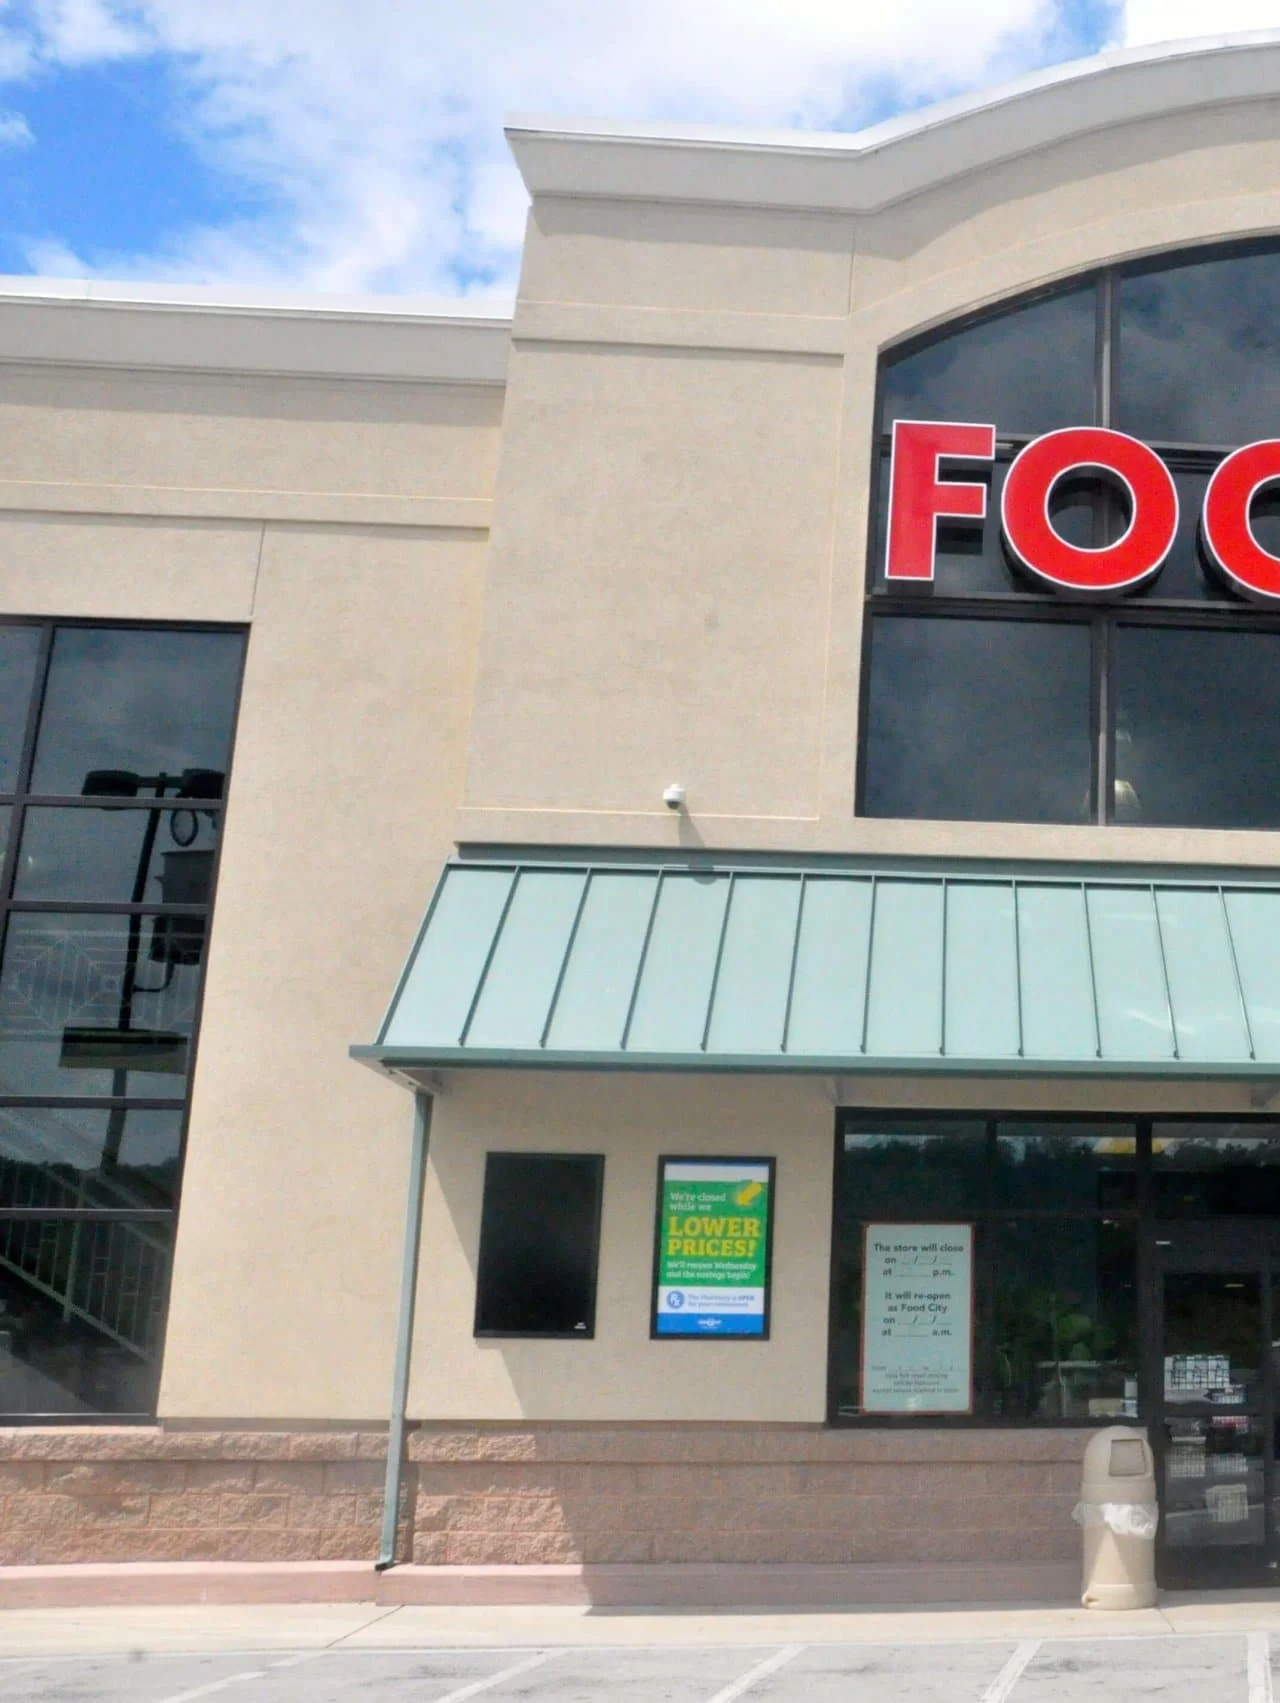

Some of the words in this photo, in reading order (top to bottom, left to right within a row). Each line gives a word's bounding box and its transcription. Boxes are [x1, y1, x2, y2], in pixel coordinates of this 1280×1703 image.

[668, 1215, 761, 1237] LOWER
[667, 1238, 758, 1257] PRICES!
[873, 1243, 891, 1252] The
[893, 1243, 918, 1252] store
[920, 1243, 938, 1252] will
[939, 1243, 964, 1252] close
[882, 1268, 892, 1276] at
[932, 1269, 955, 1278] p.m.
[884, 1291, 892, 1300] It
[894, 1291, 912, 1300] will
[913, 1292, 951, 1302] re-open
[901, 1303, 926, 1312] Food
[927, 1303, 948, 1314] City
[881, 1328, 892, 1336] at
[931, 1329, 953, 1337] a.m.
